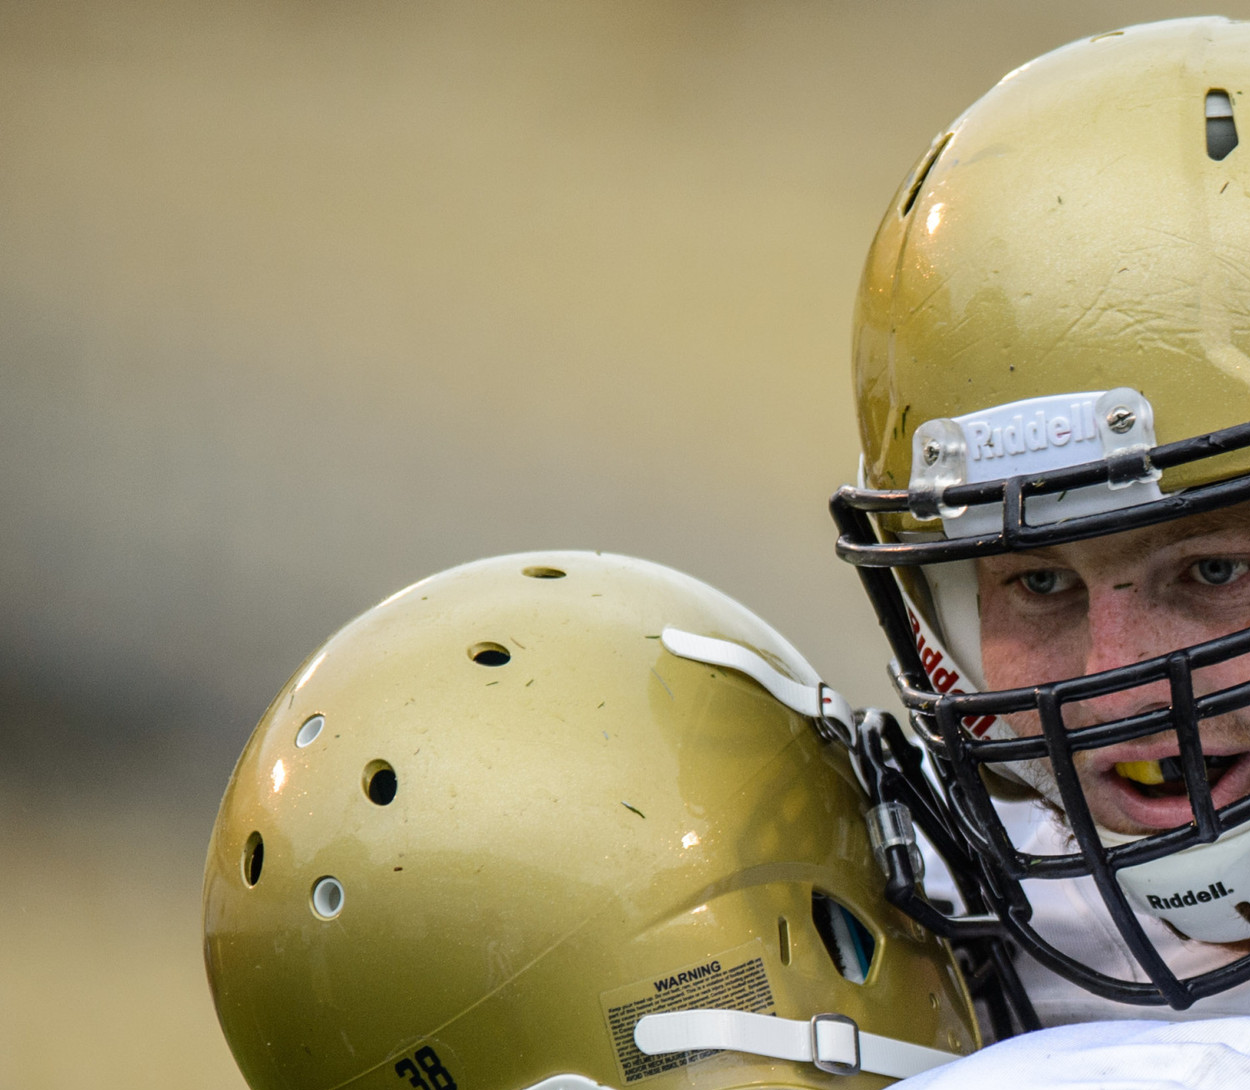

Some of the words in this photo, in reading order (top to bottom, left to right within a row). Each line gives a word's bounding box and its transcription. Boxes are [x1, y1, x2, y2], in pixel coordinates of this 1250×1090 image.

[967, 401, 1096, 461] Riddell
[907, 607, 997, 737] Riddll
[654, 961, 722, 992] WARNING
